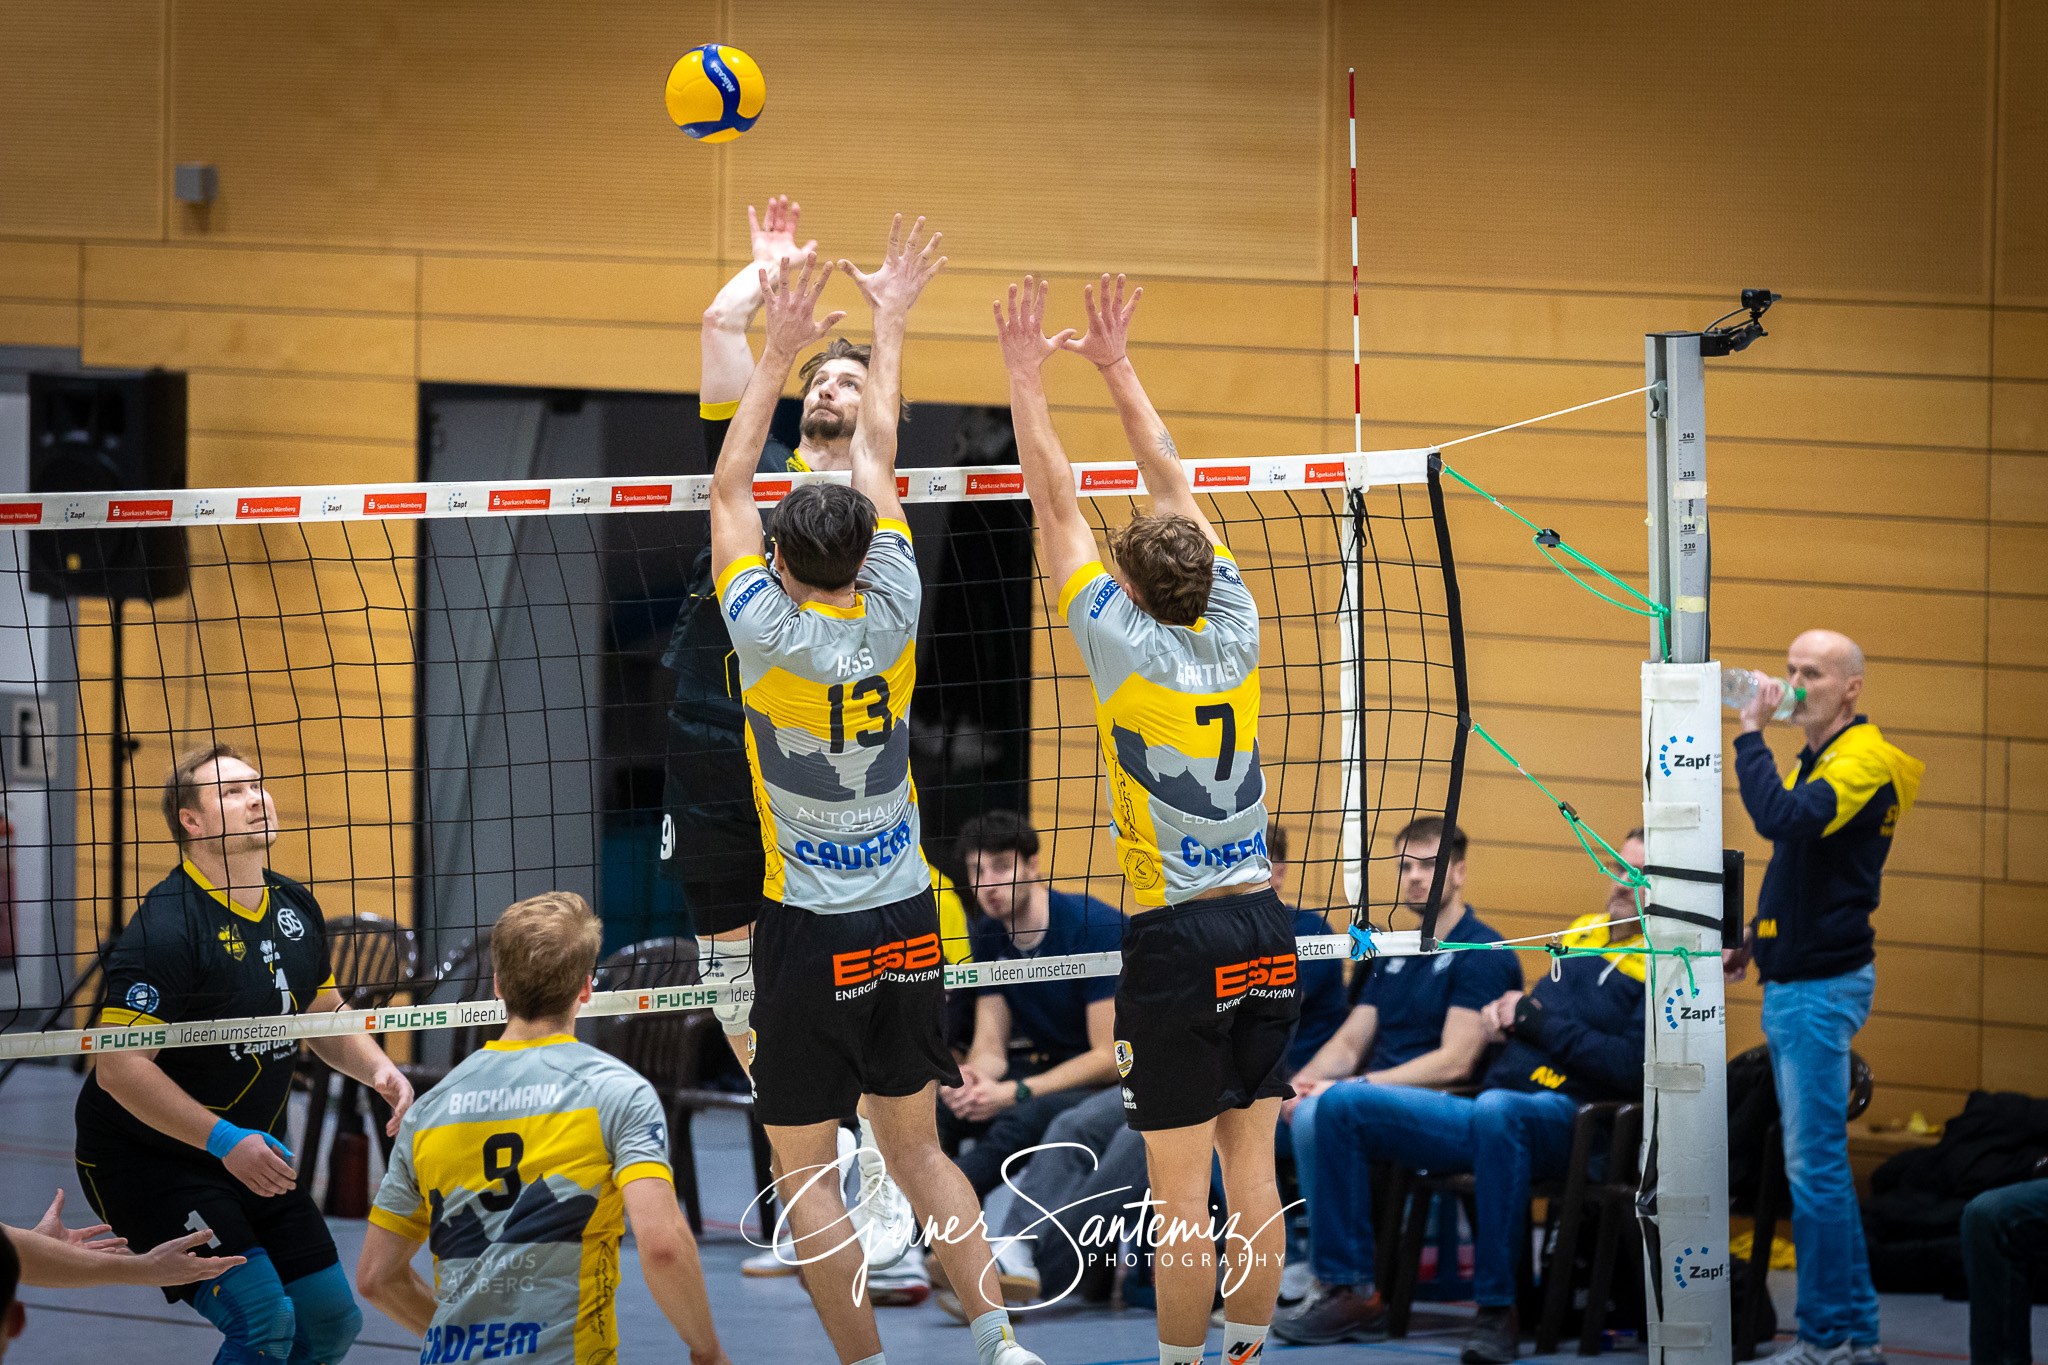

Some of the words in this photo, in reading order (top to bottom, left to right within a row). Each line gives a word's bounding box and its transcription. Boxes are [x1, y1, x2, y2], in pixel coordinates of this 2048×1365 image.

[1274, 473, 1287, 481] Zapf
[933, 484, 947, 492] Zapf
[328, 504, 342, 512] Zapf
[453, 501, 468, 509] Zapf
[576, 496, 591, 504] Zapf
[70, 511, 86, 519] Zapf
[828, 675, 892, 753] 13
[1195, 703, 1236, 781] 7
[1674, 754, 1711, 770] Zapf
[660, 814, 676, 860] 9
[833, 933, 941, 987] ESB
[1296, 942, 1334, 957] setzen
[944, 969, 978, 985] CHS
[990, 966, 1024, 981] Ideen
[1027, 962, 1086, 978] umsetzen
[1215, 953, 1297, 998] ESB
[835, 979, 878, 1001] ENERGIE
[880, 968, 940, 983] ÜDBAYERN
[1249, 988, 1295, 999] DBAYERN
[657, 990, 717, 1008] FUCHS
[730, 986, 755, 1002] Idee
[384, 1010, 447, 1028] FUCHS
[460, 1007, 496, 1024] Ideen
[1681, 1006, 1716, 1022] Zapf
[100, 1030, 166, 1049] FUCHS
[180, 1027, 217, 1043] Ideen
[221, 1024, 287, 1041] umsetzen
[448, 1084, 562, 1115] BACHMANN
[478, 1132, 524, 1212] 9
[184, 1210, 222, 1249] 1
[1690, 1263, 1724, 1280] Zapf
